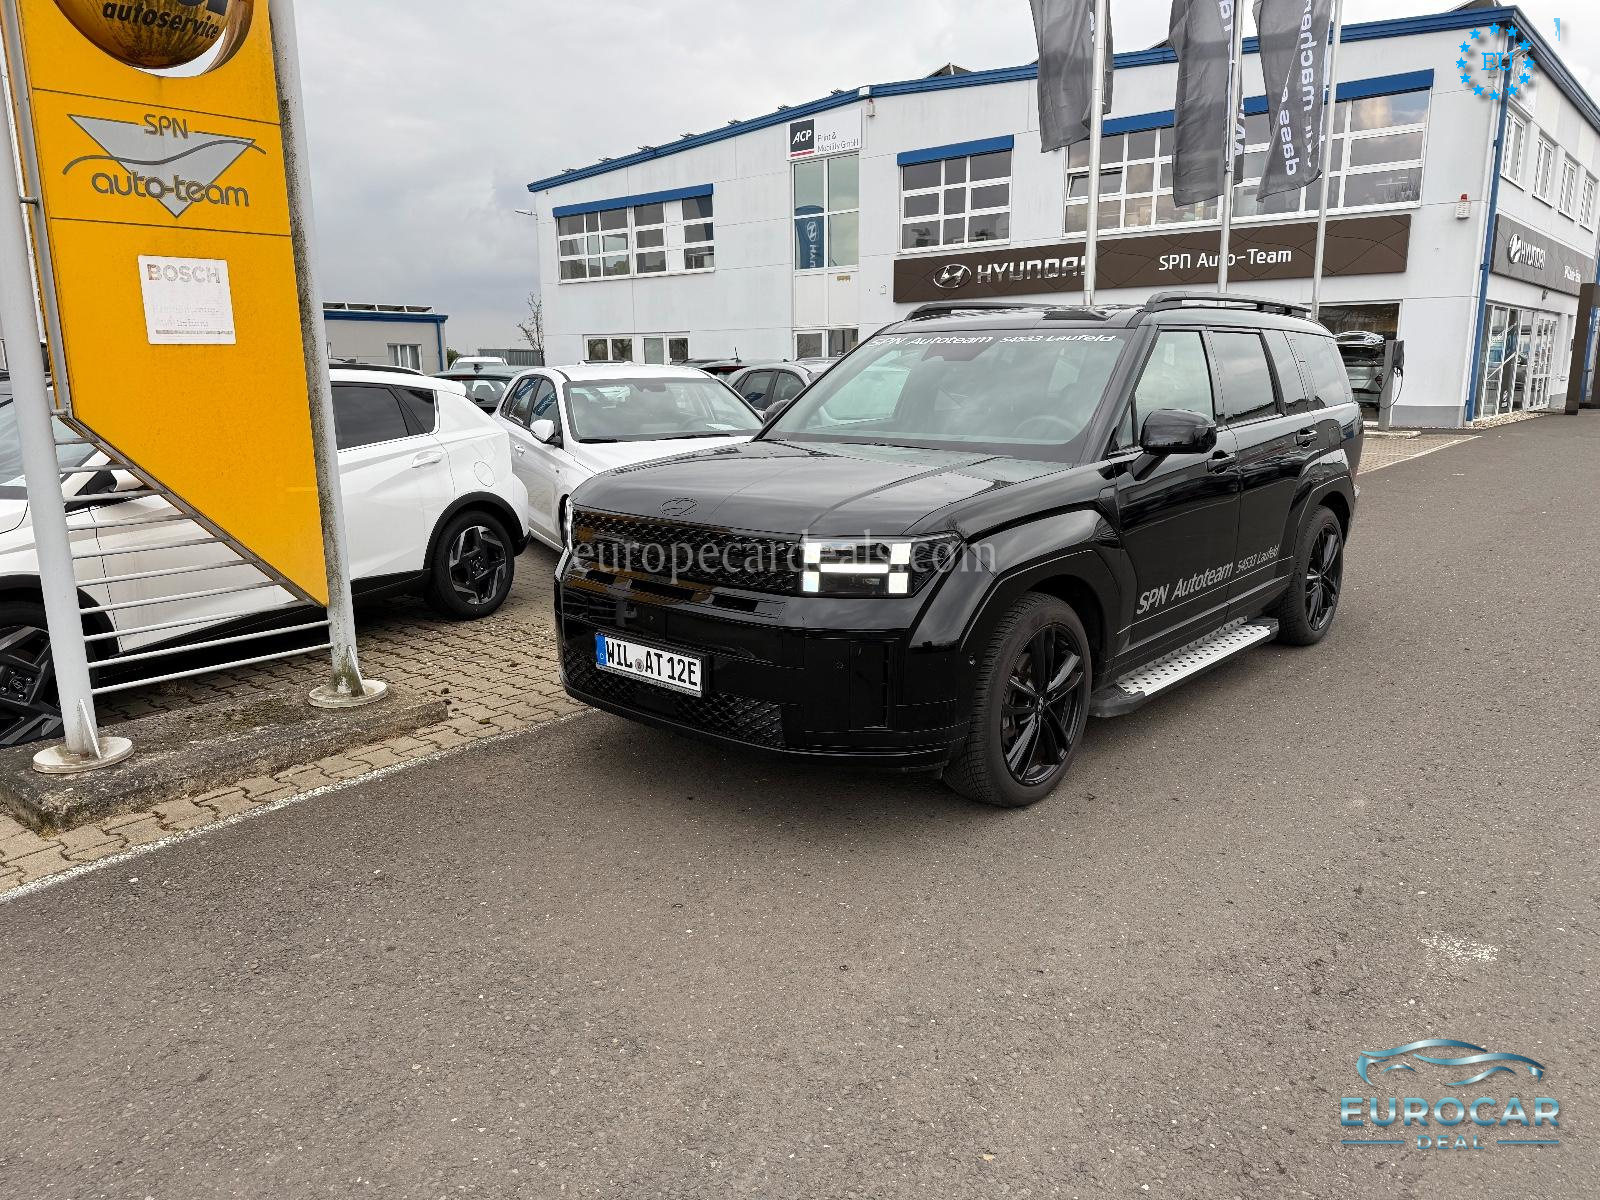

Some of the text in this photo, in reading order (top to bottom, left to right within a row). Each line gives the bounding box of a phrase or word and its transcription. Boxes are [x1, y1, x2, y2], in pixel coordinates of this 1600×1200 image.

[102, 1, 220, 40] autoservice
[143, 113, 189, 139] SPN
[792, 129, 813, 145] ACP
[91, 170, 249, 207] auto-team
[1158, 249, 1293, 271] SPN Auo-Team
[147, 264, 221, 284] BOSCH
[867, 337, 907, 347] SPN
[905, 336, 994, 346] Autoteam
[1136, 583, 1170, 615] SPN
[1171, 561, 1234, 602] Autoteam
[606, 641, 633, 669] WIL
[645, 650, 663, 677] AT
[667, 656, 698, 687] 12E
